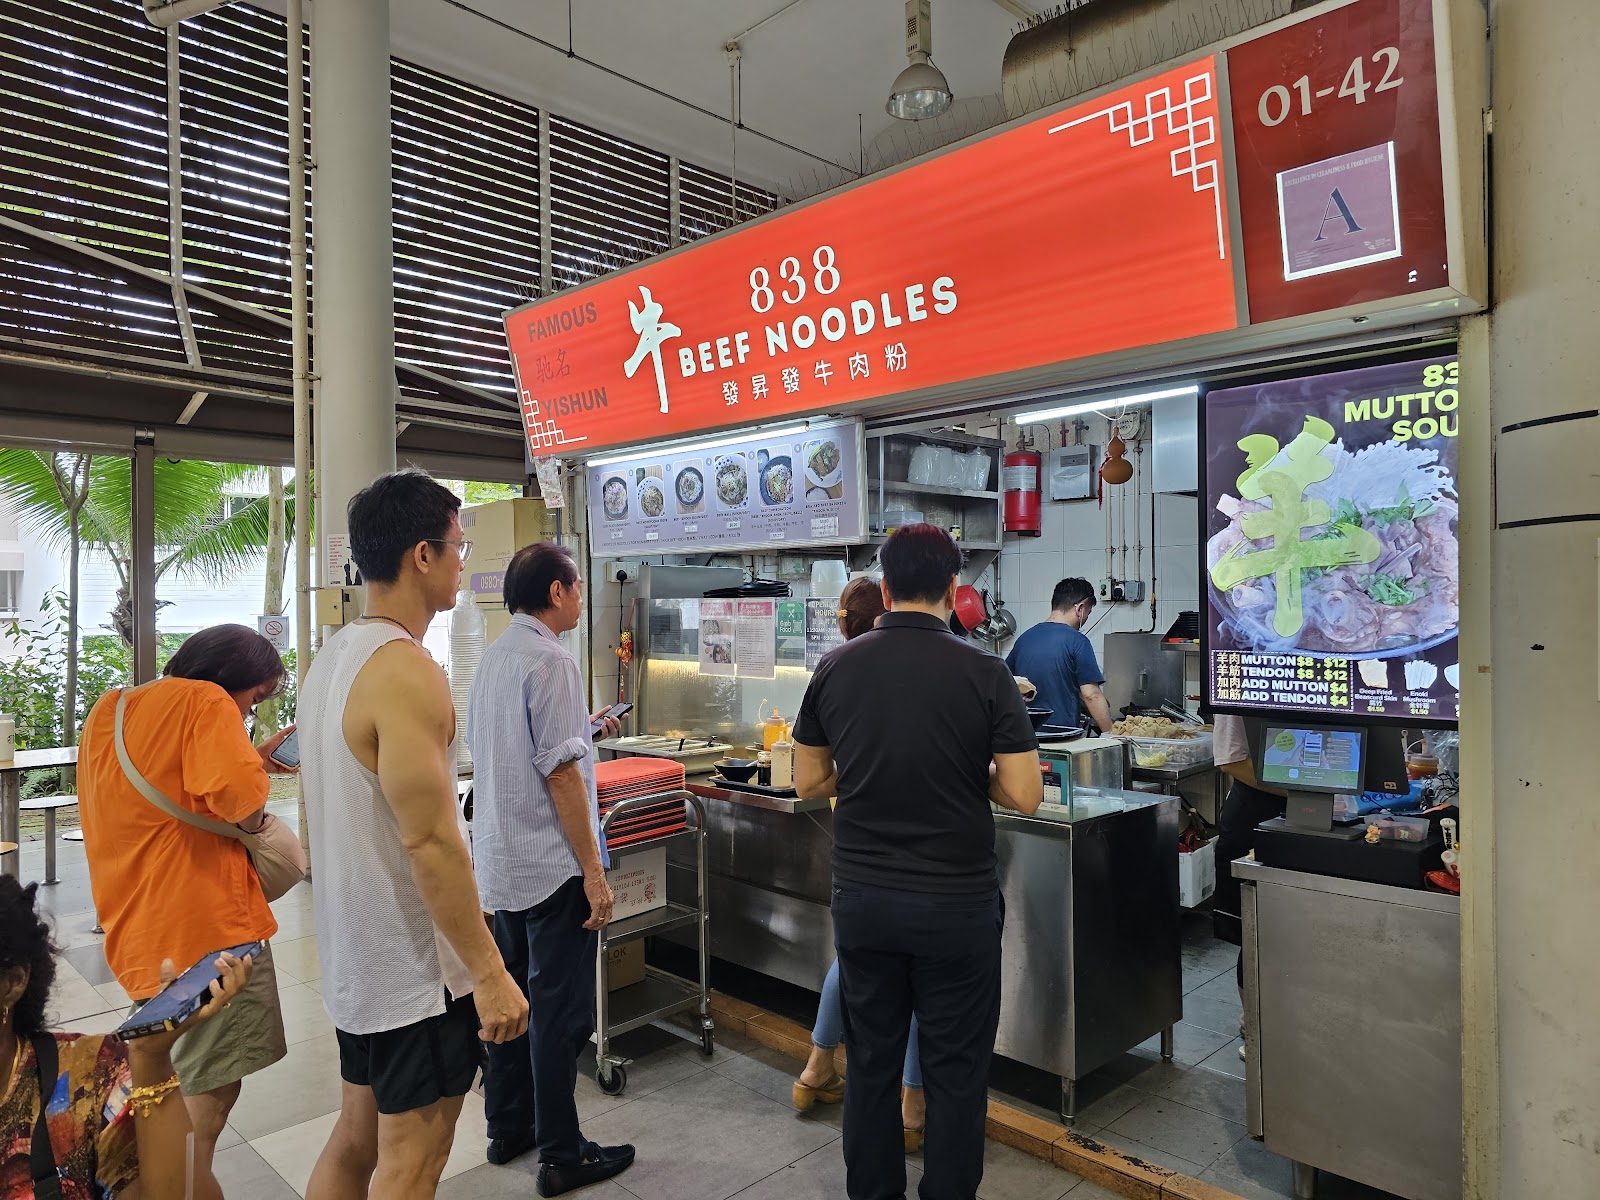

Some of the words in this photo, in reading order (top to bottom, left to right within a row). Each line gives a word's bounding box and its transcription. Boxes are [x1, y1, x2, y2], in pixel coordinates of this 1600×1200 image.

[1257, 46, 1405, 127] 01-42
[1312, 186, 1366, 243] A
[749, 245, 842, 315] 838
[527, 301, 598, 343] FAMOUS
[678, 331, 751, 379] BEEF
[764, 275, 959, 358] NOODLES
[536, 348, 571, 383] 驰名
[623, 285, 682, 414] 牛
[722, 342, 908, 406] 發昇發牛肉粉
[542, 386, 608, 420] YISHUN
[1216, 652, 1240, 665] 羊肉
[1241, 654, 1297, 666] MUTTON
[1324, 657, 1347, 669] $12
[1216, 664, 1241, 677] 羊筋
[1241, 666, 1295, 678] TENDON
[1324, 668, 1347, 681] $12
[1216, 676, 1240, 689] 加肉
[1241, 678, 1270, 689] ADD
[1272, 680, 1329, 693] MUTTON
[1330, 681, 1348, 694] $4
[1216, 688, 1241, 700] 加筋
[1241, 690, 1270, 702] ADD
[1271, 692, 1327, 705] TENDON
[1330, 694, 1348, 707] $4
[1355, 694, 1383, 702] Beancurd
[1359, 688, 1376, 696] Deep
